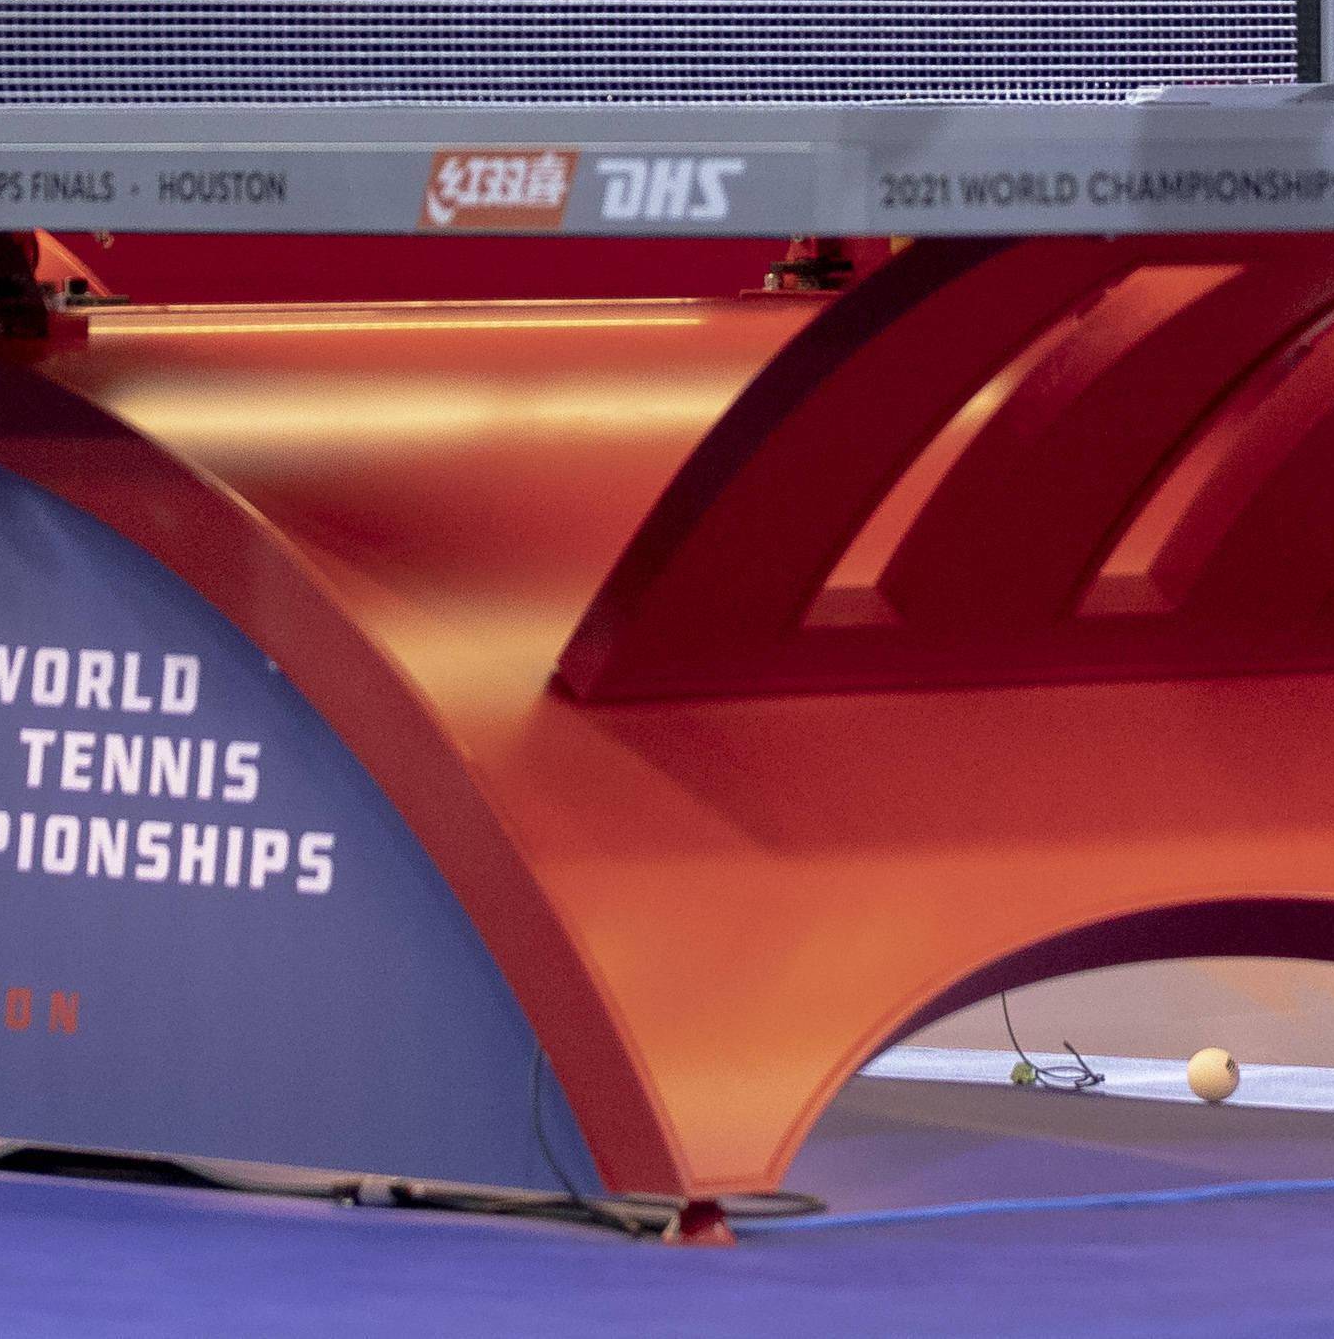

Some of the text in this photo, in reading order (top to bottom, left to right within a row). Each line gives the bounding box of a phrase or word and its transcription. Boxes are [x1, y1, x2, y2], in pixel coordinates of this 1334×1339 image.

[30, 170, 115, 202] FINALS
[157, 170, 287, 203] HOUSTON
[595, 157, 746, 221] DHS
[879, 172, 950, 207] 2021
[961, 171, 1078, 206] WORLD
[19, 727, 262, 803] TENNIS
